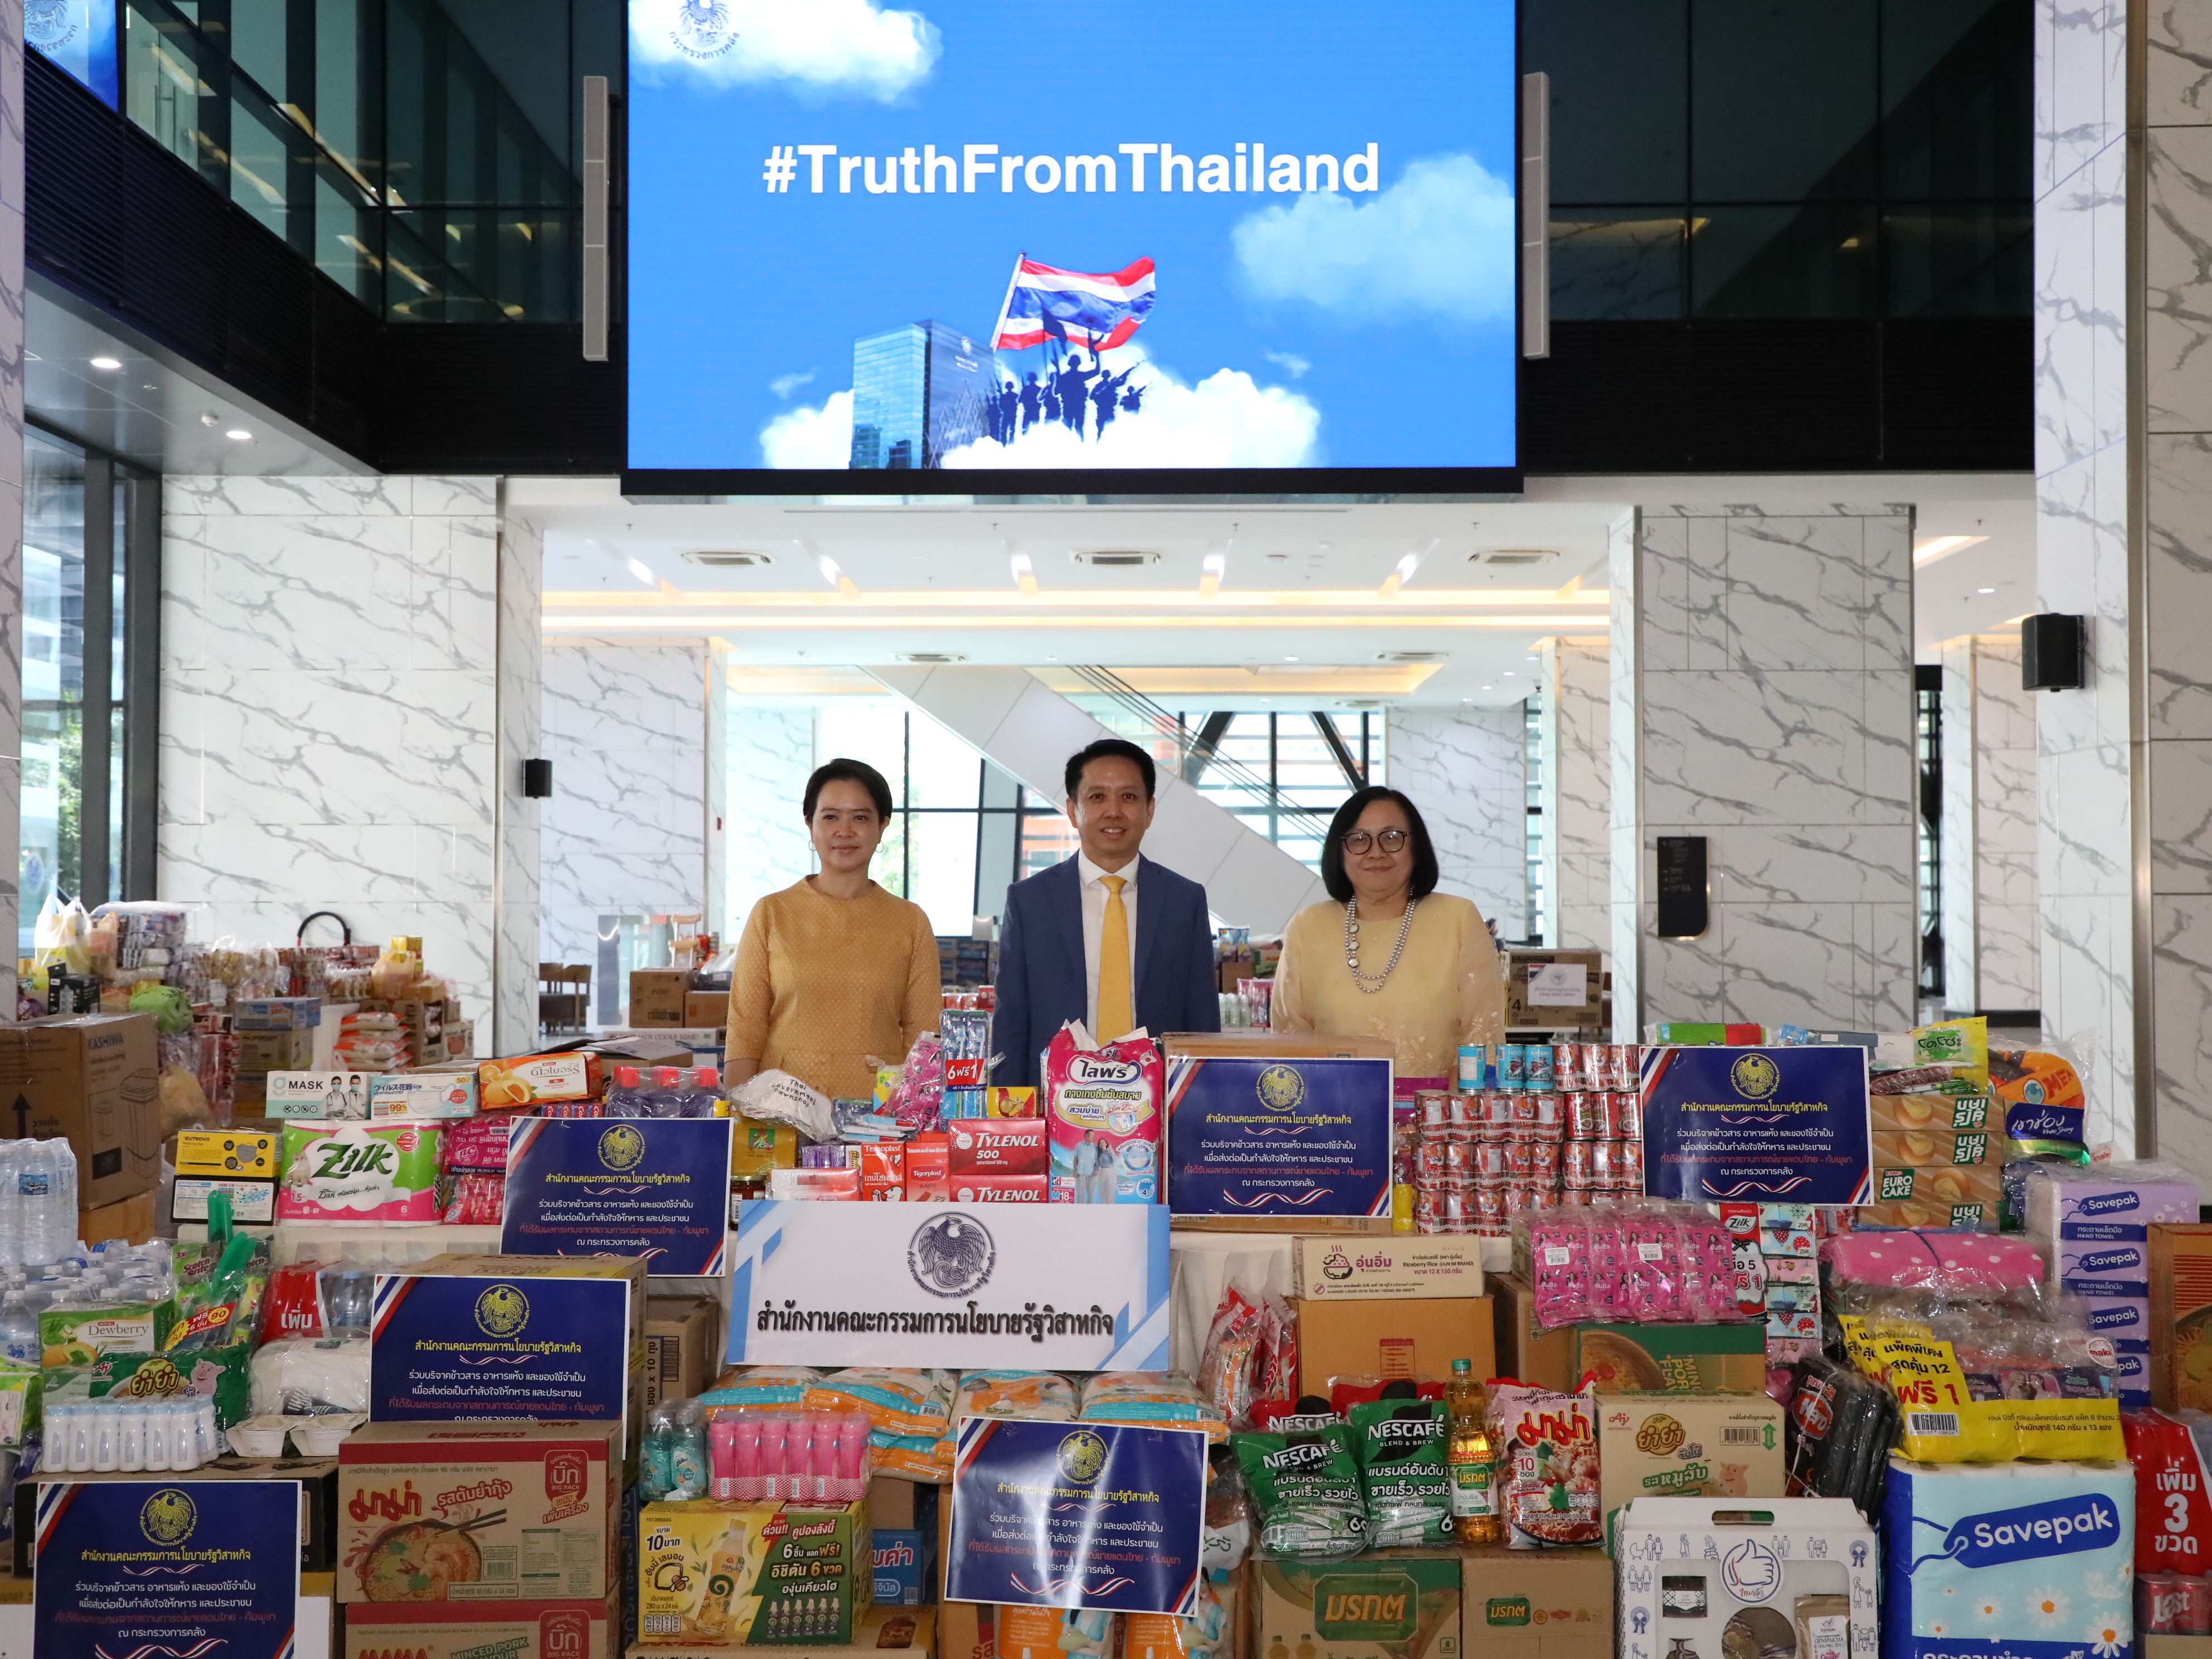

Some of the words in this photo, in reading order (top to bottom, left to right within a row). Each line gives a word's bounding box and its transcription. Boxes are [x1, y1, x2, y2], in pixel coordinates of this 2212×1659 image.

[763, 142, 1379, 193] #TruthFromThailand
[88, 1032, 124, 1050] KASHIWA
[1918, 1033, 1962, 1049] โดโซะ
[289, 1080, 323, 1089] MASK
[790, 1079, 807, 1090] Thai
[771, 1084, 817, 1105] Government
[1065, 1088, 1142, 1100] กางเกงซึมซับสบาย
[1069, 1106, 1100, 1115] สวมง่าย
[1681, 1102, 1828, 1114] สำนักงานคณะกรรมการนโยบายรัฐวิสาหกิจ
[1206, 1112, 1352, 1125] สำนักงานคณะกรรมการนโยบายรัฐวิสาหกิจ
[2011, 1109, 2065, 1132] เขาช่อง
[1677, 1128, 1742, 1138] ร่วมบริจาคข้าวสาร
[1743, 1127, 1779, 1138] อาหารแห้ง
[1781, 1128, 1834, 1138] และของใช้จำเป็น
[2043, 1127, 2057, 1136] Khao
[756, 1141, 774, 1149] Rice
[976, 1132, 1039, 1149] TYLENOL
[1201, 1139, 1264, 1149] ร่วมบริจาคข้าวสาร
[1265, 1141, 1301, 1150] อาหารแห้ง
[1303, 1141, 1356, 1151] และของใช้จำเป็น
[1681, 1141, 1786, 1152] เพื่อส่งต่อเป็นกำลังใจให้ทหาร
[1787, 1143, 1831, 1151] และประชาชน
[311, 1143, 394, 1179] Zilk
[976, 1150, 1000, 1159] 500
[1204, 1153, 1307, 1163] เพื่อส่งต่อเป็นกำลังใจให้ทหาร
[1309, 1154, 1353, 1163] และประชาชน
[1731, 1166, 1793, 1176] กระทรวงการคลัง
[545, 1172, 690, 1186] สำนักงานคณะกรรมการนโยบายรัฐวิสาหกิจ
[1252, 1177, 1315, 1188] กระทรวงการคลัง
[1882, 1176, 1913, 1189] EURO
[977, 1187, 1040, 1202] TYLENOL
[1881, 1185, 1912, 1198] CAKE
[539, 1199, 601, 1210] ร่วมบริจาคข้าวสาร
[604, 1199, 638, 1210] อาหารแห้ง
[641, 1200, 693, 1210] และของใช้จำเป็น
[2088, 1194, 2138, 1211] Savepak
[541, 1212, 644, 1223] เพื่อส่งต่อเป็นกำลังใจให้ทหาร
[647, 1214, 690, 1223] และประชาชน
[1728, 1217, 1751, 1229] Zilk
[2077, 1226, 2122, 1234] กระดาษเช็ดมือ
[587, 1236, 650, 1247] กระทรวงการคลัง
[1356, 1251, 1392, 1272] อุ่นอิ่ม
[2089, 1251, 2138, 1267] Savepak
[211, 1310, 226, 1320] 90
[281, 1303, 313, 1330] เพิ่ม
[757, 1299, 1114, 1341] สำนักงานคณะกรรมการนโยบายรัฐวิสาหกิจ
[89, 1324, 149, 1337] Dewberry
[415, 1338, 582, 1355] สำนักงานคณะกรรมการนโยบายรัฐวิสาหกิจ
[1884, 1340, 1943, 1358] แพ็คพิเศษ
[1891, 1357, 1929, 1376] สุดคุ้ม
[1931, 1364, 1951, 1374] 12
[132, 1364, 180, 1395] ยำยำ
[409, 1370, 481, 1381] ร่วมบริจาคข้าวสาร
[483, 1370, 524, 1382] อาหารแห้ง
[526, 1371, 586, 1383] และของใช้จำเป็น
[412, 1385, 530, 1397] เพื่อส่งต่อเป็นกำลังใจให้ทหาร
[532, 1387, 581, 1398] และประชาชน
[1897, 1380, 1938, 1404] ฟรี
[1944, 1383, 1959, 1405] 1
[1367, 1414, 1445, 1441] NESCAFÉ
[1517, 1402, 1590, 1446] มาม่า
[2014, 1422, 2051, 1432] น้ำหนักสุทธิ
[1637, 1422, 1686, 1451] ยำยำ
[1262, 1438, 1343, 1468] NESCAFÉ
[1313, 1459, 1333, 1469] BREW
[1518, 1458, 1535, 1471] 10
[552, 1462, 580, 1485] บิ๊ก
[1459, 1472, 1486, 1483] มรกต
[2156, 1461, 2197, 1492] เพิ่ม
[437, 1478, 513, 1507] รสต้มยำกุ้ง
[997, 1482, 1160, 1503] สำนักงานคณะกรรมการนโยบายรัฐวิสาหกิจ
[1277, 1485, 1321, 1499] ขายเร็ว
[1325, 1487, 1359, 1500] รวยไว
[1371, 1480, 1414, 1496] ขายเร็ว
[348, 1480, 422, 1522] มาม่า
[2164, 1492, 2189, 1534] 3
[763, 1524, 788, 1536] ด่วน!!
[792, 1519, 837, 1540] คูปองลังนี้
[1104, 1520, 1163, 1533] และของใช้จำเป็น
[1974, 1502, 2113, 1549] Savepak
[1109, 1538, 1159, 1549] และประชาชน
[2155, 1534, 2199, 1555] ขวด
[81, 1546, 251, 1563] สำนักงานคณะกรรมการนโยบายรัฐวิสาหกิจ
[771, 1563, 807, 1578] อิชิตัน
[811, 1562, 821, 1576] 6
[823, 1564, 842, 1575] ขวด
[75, 1581, 145, 1592] ร่วมบริจาคข้าวสาร
[147, 1582, 190, 1593] อาหารแห้ง
[192, 1581, 256, 1592] และของใช้จำเป็น
[782, 1580, 837, 1597] องุ่นเคียวโฮ
[79, 1597, 197, 1609] เพื่อส่งต่อเป็นกำลังใจให้ทหาร
[199, 1598, 252, 1607] และประชาชน
[1324, 1593, 1408, 1623] มรกต
[1490, 1605, 1526, 1619] มรกต
[118, 1629, 128, 1638] ณ
[131, 1626, 206, 1638] กระทรวงการคลัง
[549, 1623, 579, 1650] บิ๊ก
